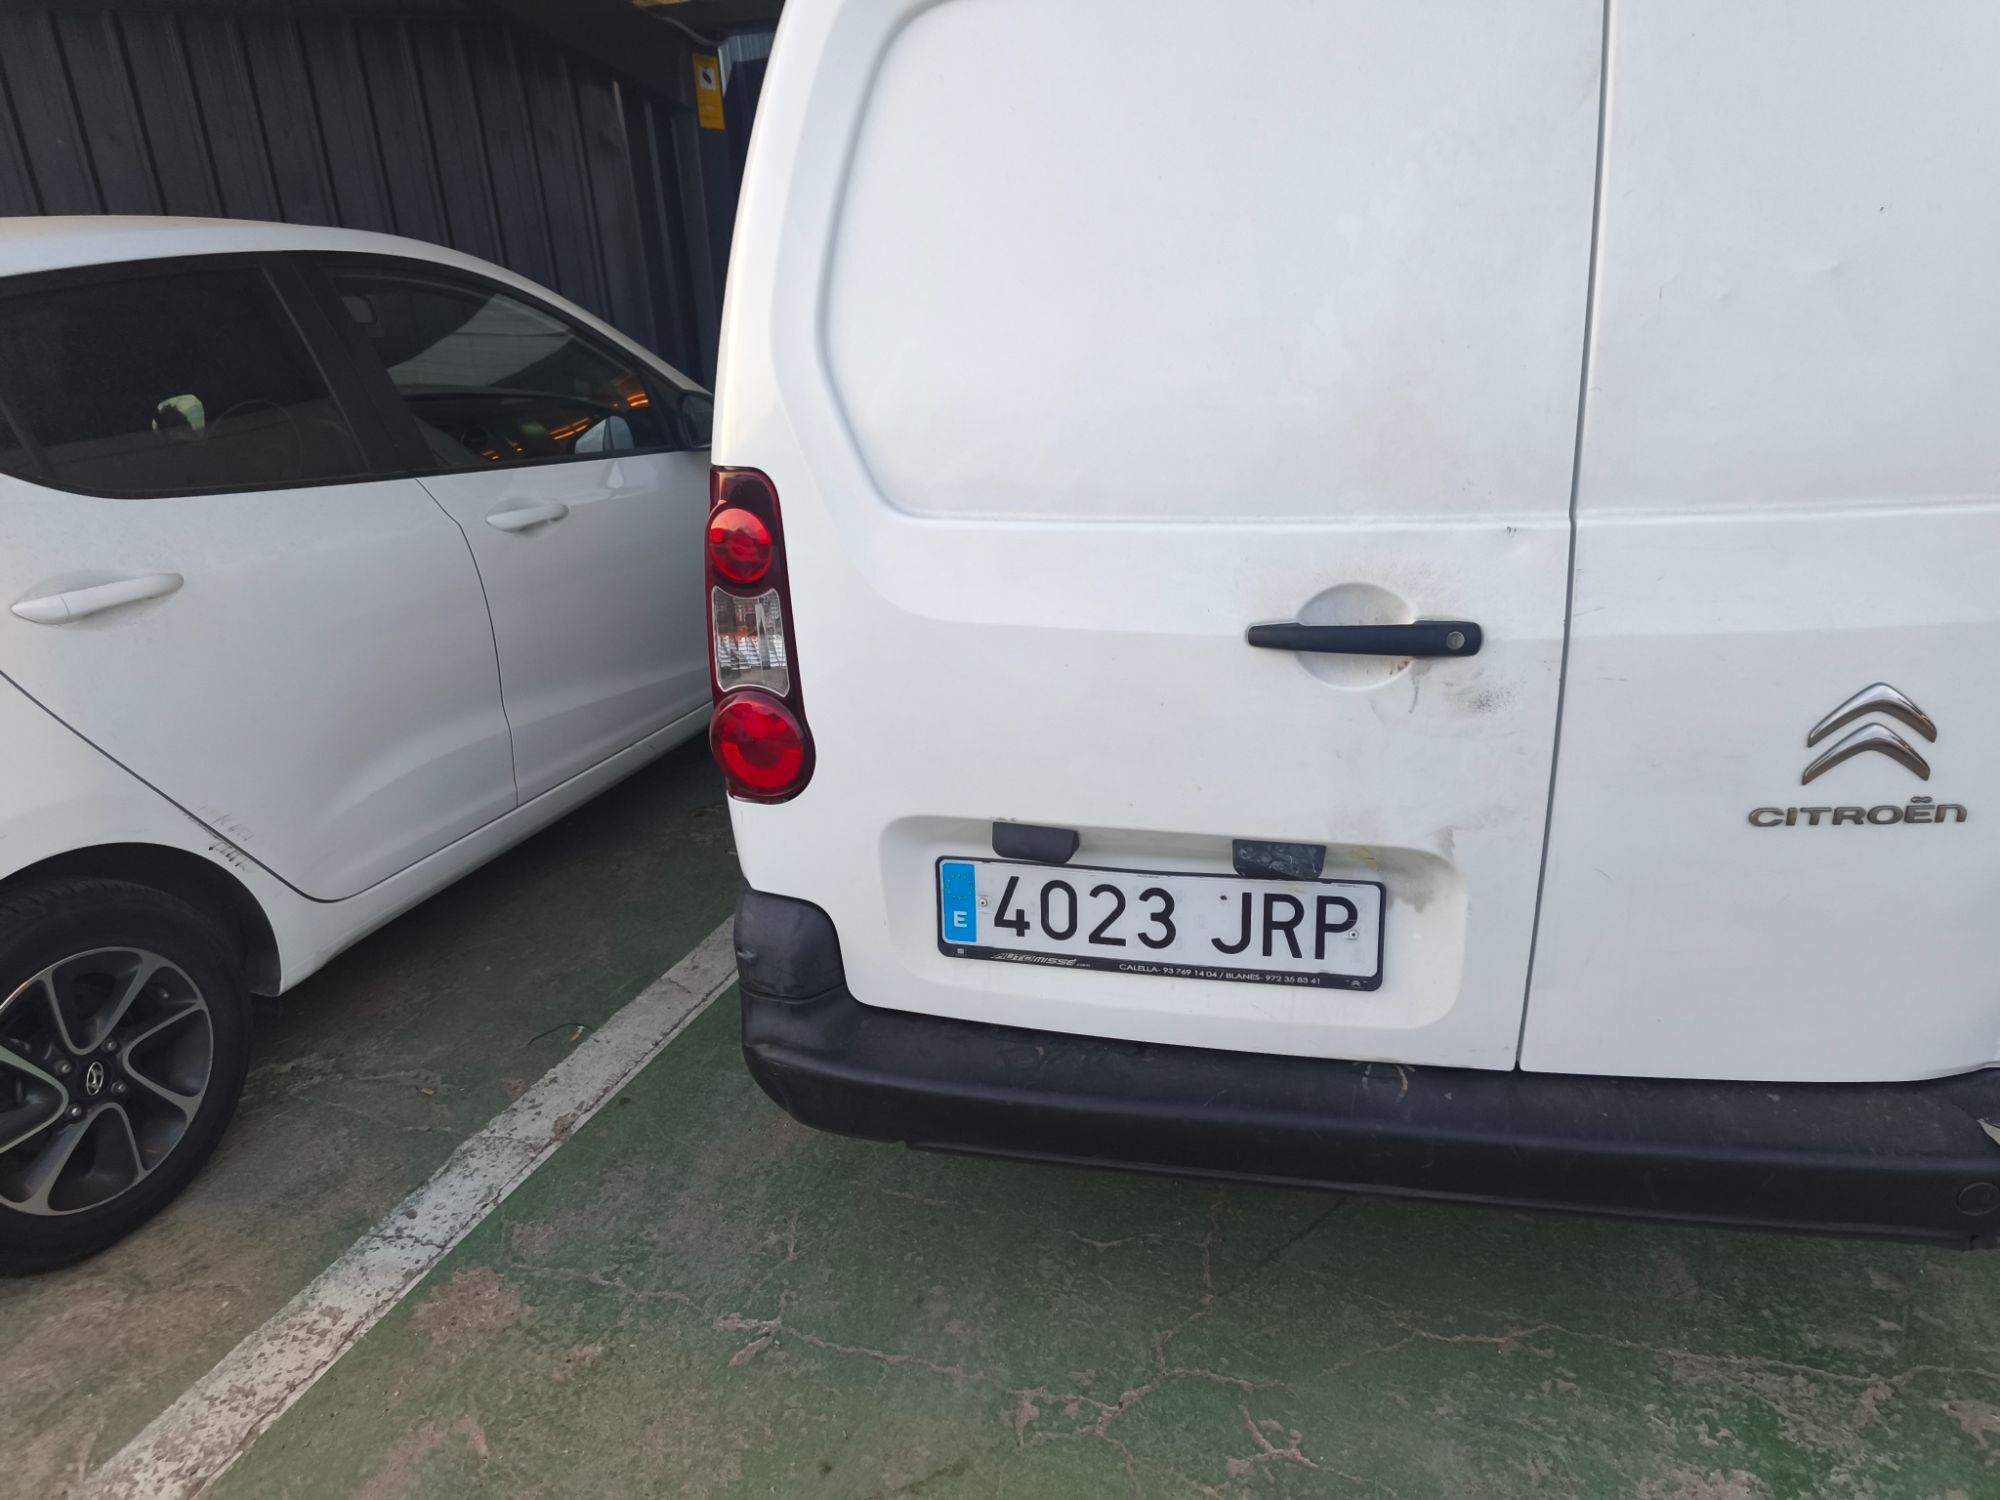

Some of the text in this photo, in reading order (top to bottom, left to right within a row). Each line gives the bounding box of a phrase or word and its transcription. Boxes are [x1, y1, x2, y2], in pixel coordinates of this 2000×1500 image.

[953, 911, 968, 928] E
[993, 875, 1359, 960] 4023 JRP
[1163, 967, 1174, 975] 93
[1175, 968, 1192, 977] 769
[1194, 970, 1204, 978] 14
[1206, 971, 1218, 979] 04
[1265, 974, 1282, 983] 972
[1284, 975, 1295, 983] 35
[1297, 976, 1308, 984] 83
[1310, 977, 1321, 985] 41
